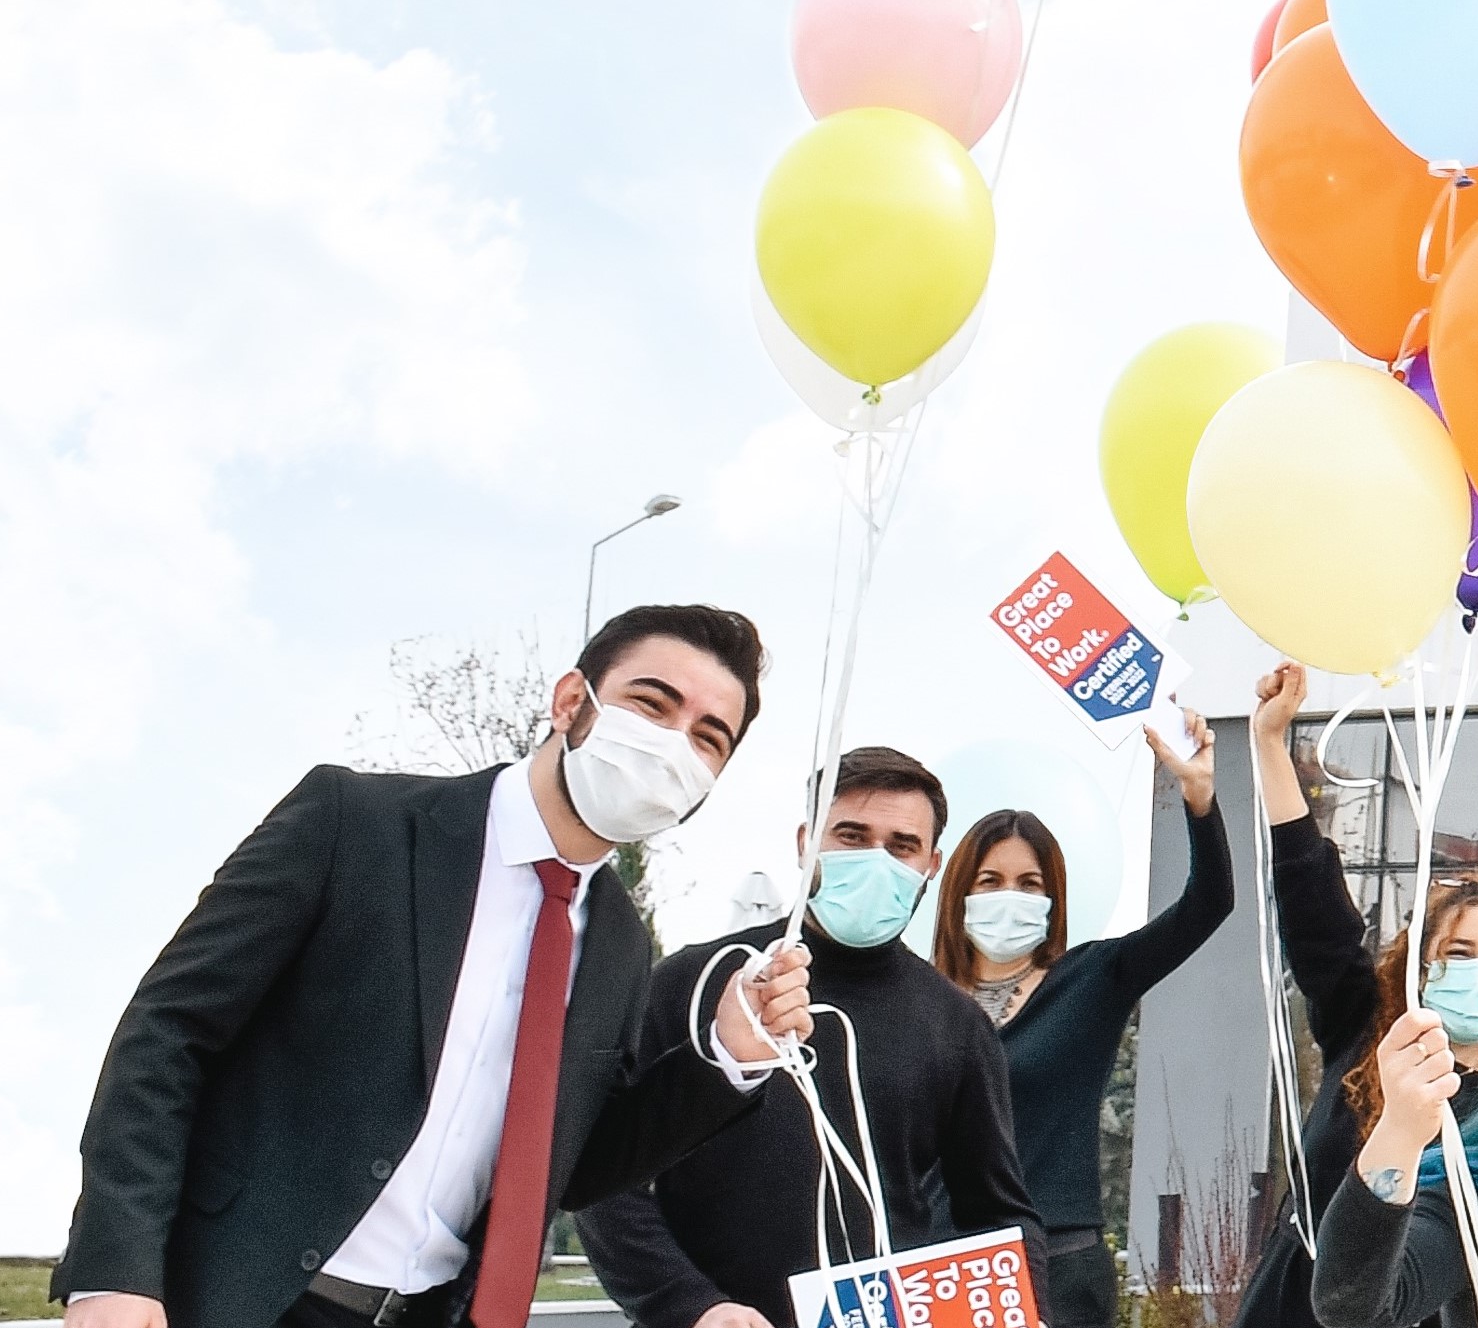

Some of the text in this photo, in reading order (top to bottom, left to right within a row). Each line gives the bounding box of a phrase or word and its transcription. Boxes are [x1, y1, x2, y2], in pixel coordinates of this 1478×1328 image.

[997, 572, 1059, 627] Great
[1013, 592, 1073, 645] Place
[1030, 636, 1061, 660] To
[1073, 632, 1144, 700] Certified
[932, 1261, 958, 1302] To
